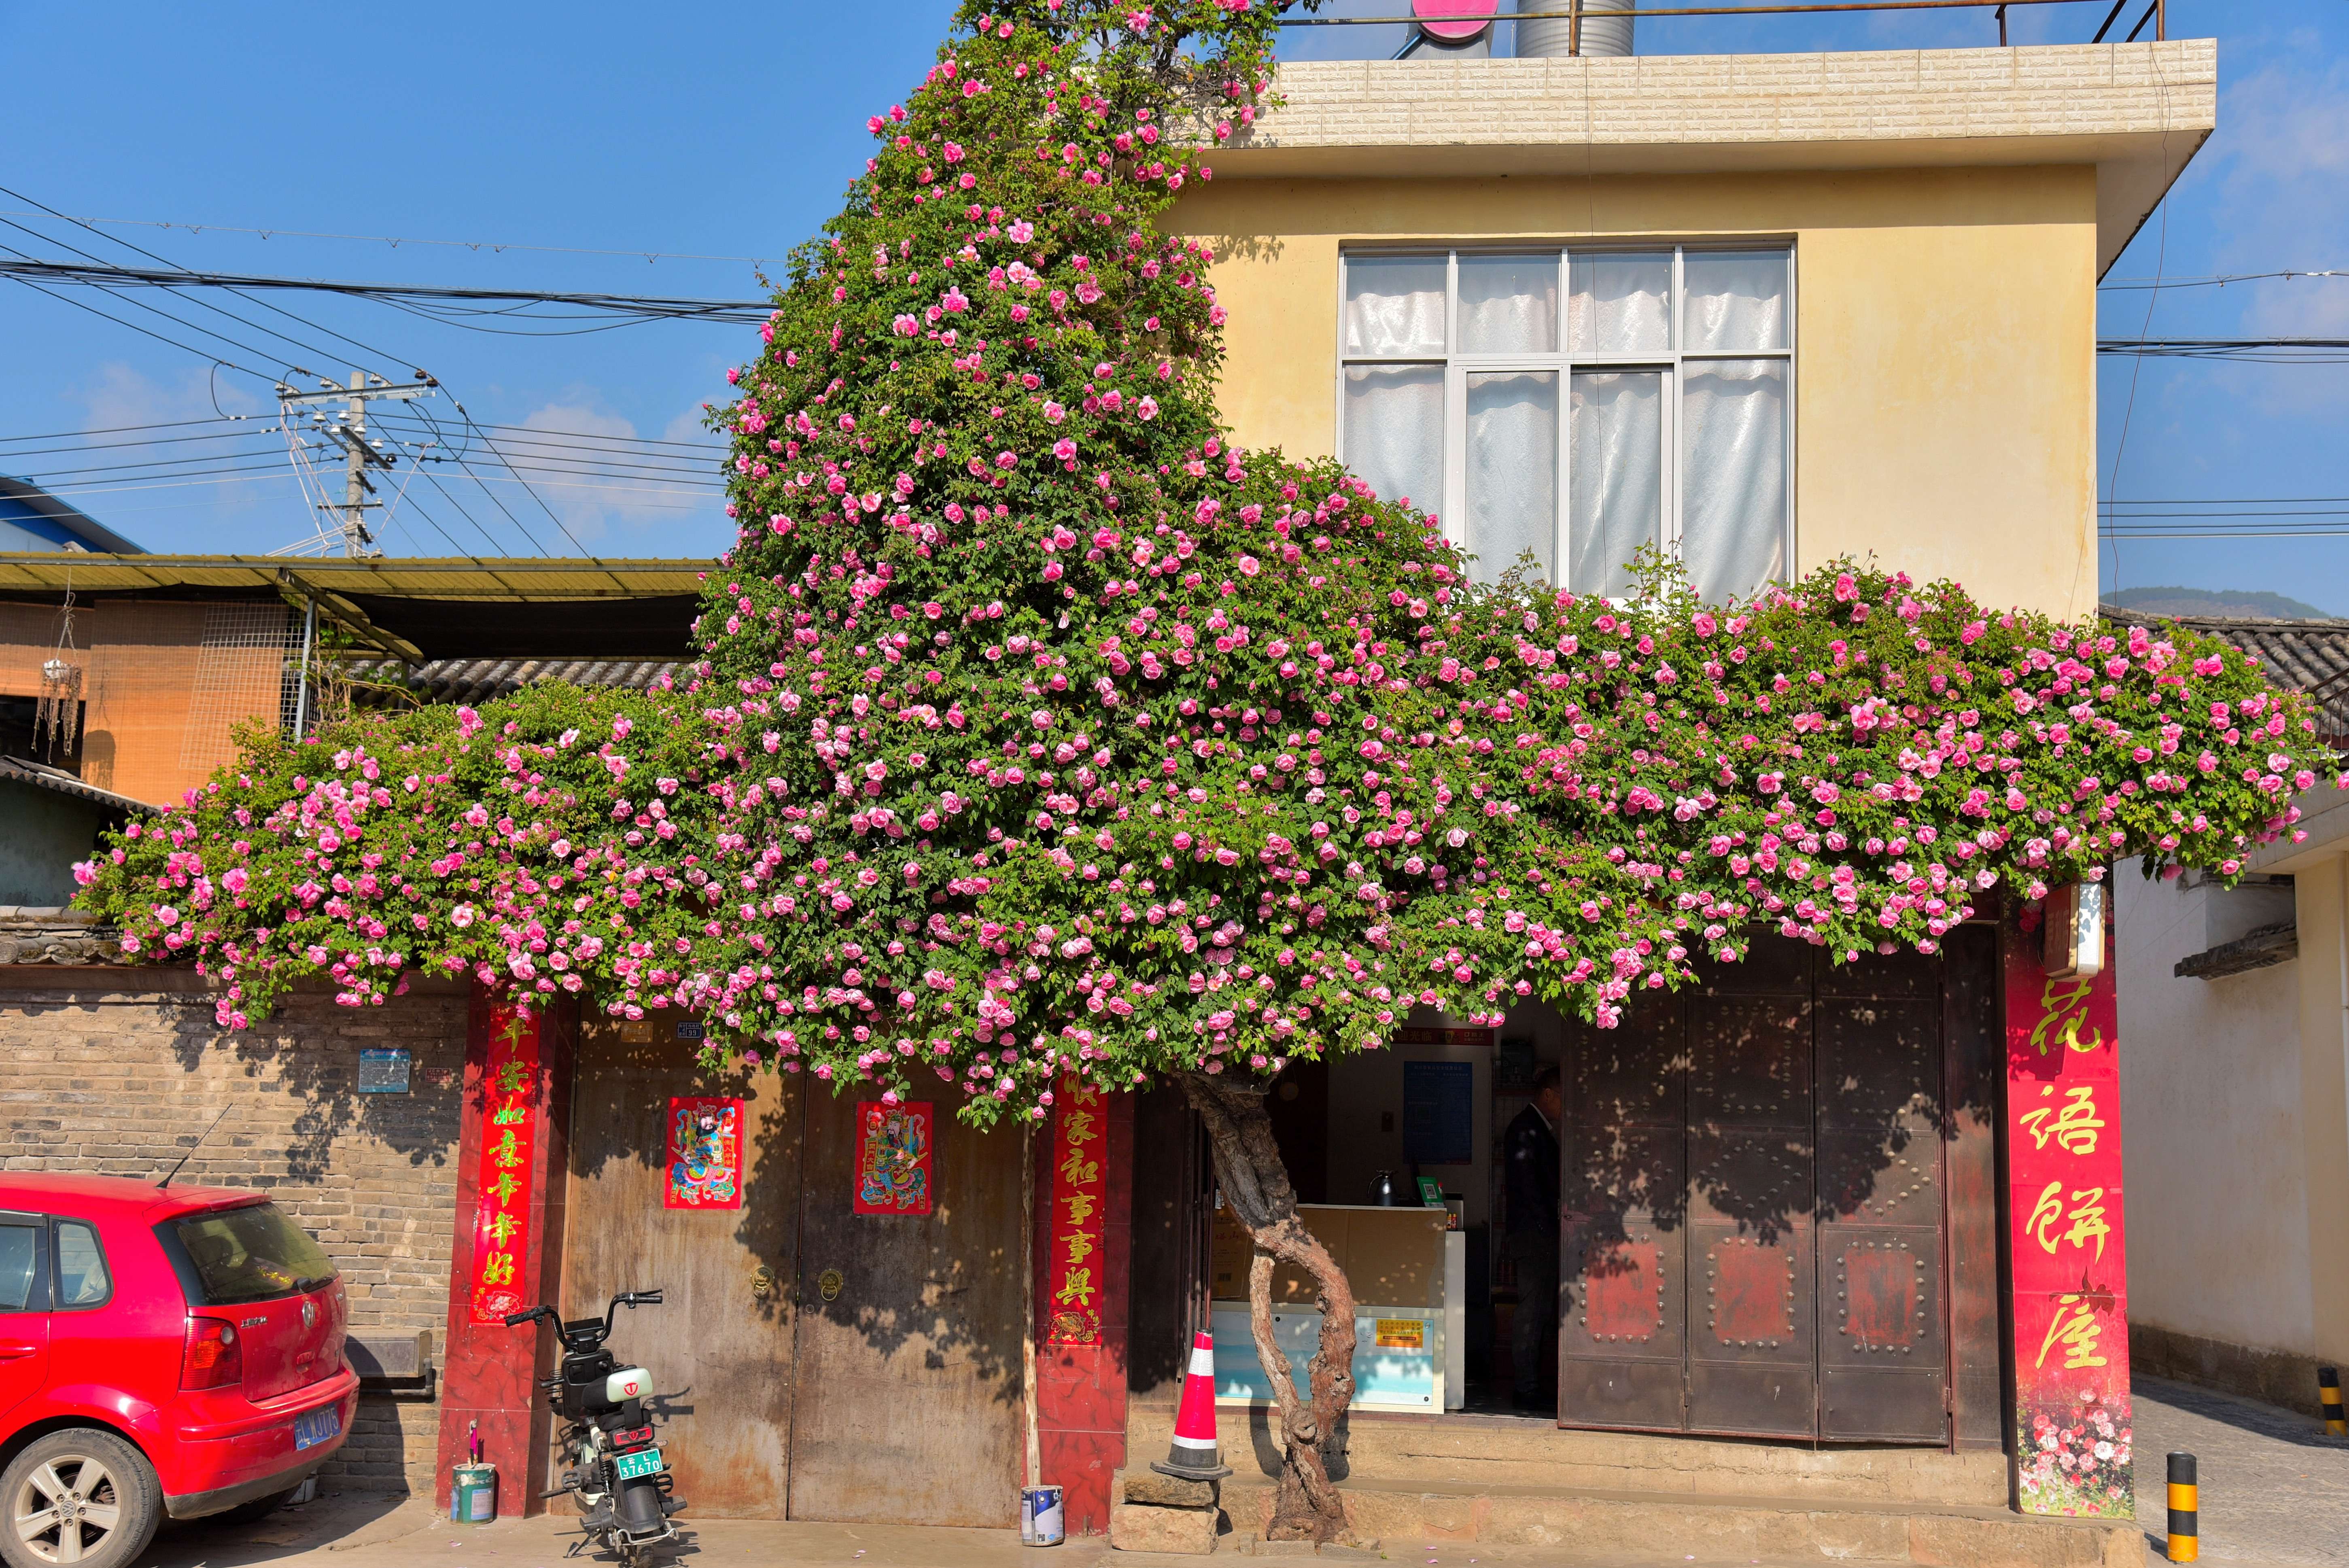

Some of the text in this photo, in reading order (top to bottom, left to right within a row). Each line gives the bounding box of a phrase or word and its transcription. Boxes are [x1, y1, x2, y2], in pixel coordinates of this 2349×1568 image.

[725, 1117, 732, 1126] 月
[482, 1017, 533, 1286] 平安如意年年好
[643, 1453, 650, 1462] L
[622, 1460, 660, 1477] 37670
